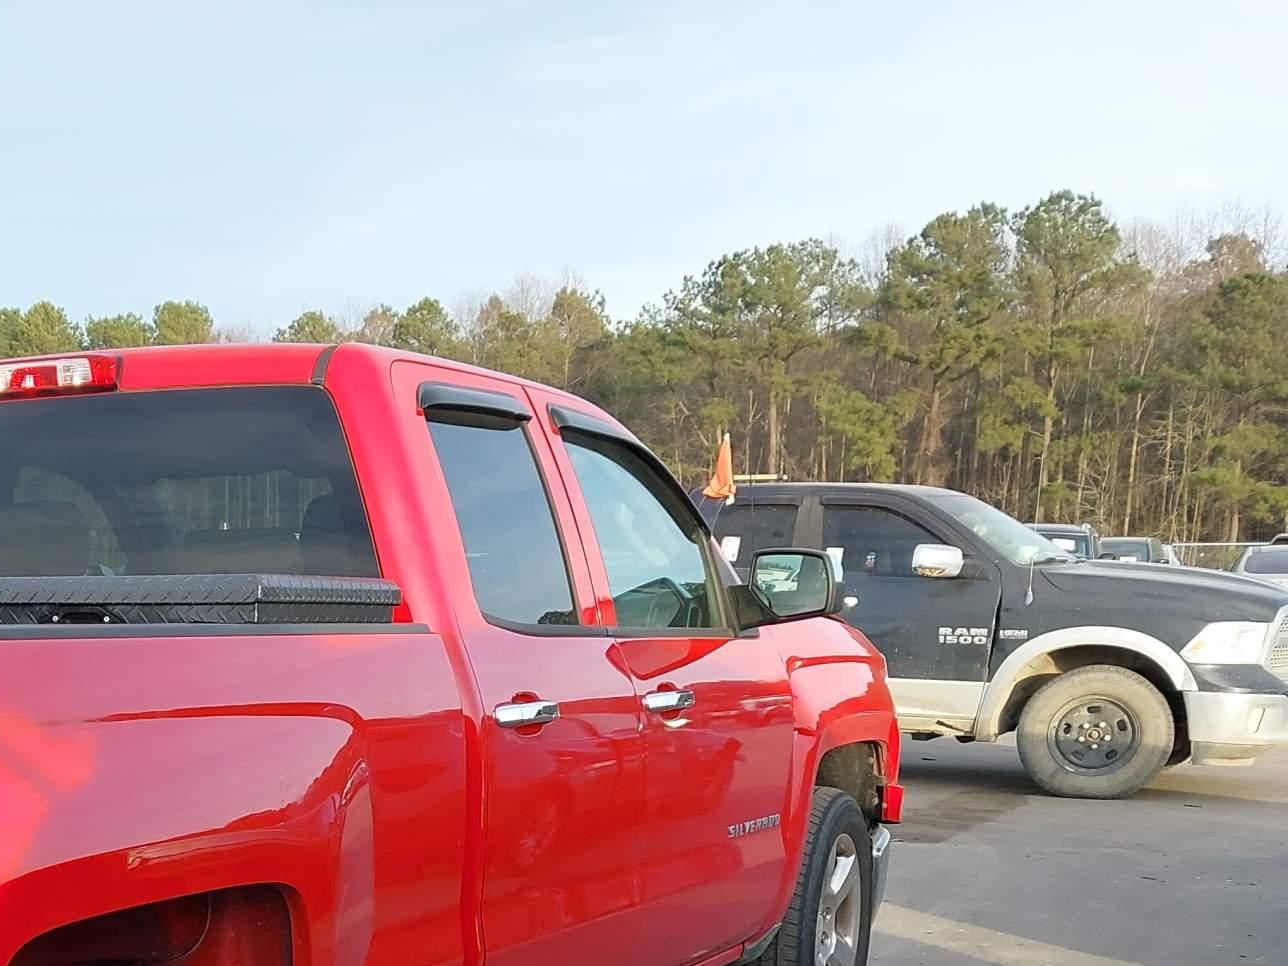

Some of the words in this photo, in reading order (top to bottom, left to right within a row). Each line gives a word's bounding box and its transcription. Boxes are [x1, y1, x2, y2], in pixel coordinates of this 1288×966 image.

[938, 627, 989, 636] RAM
[938, 635, 988, 645] 1500
[728, 813, 781, 838] SILVERADO
